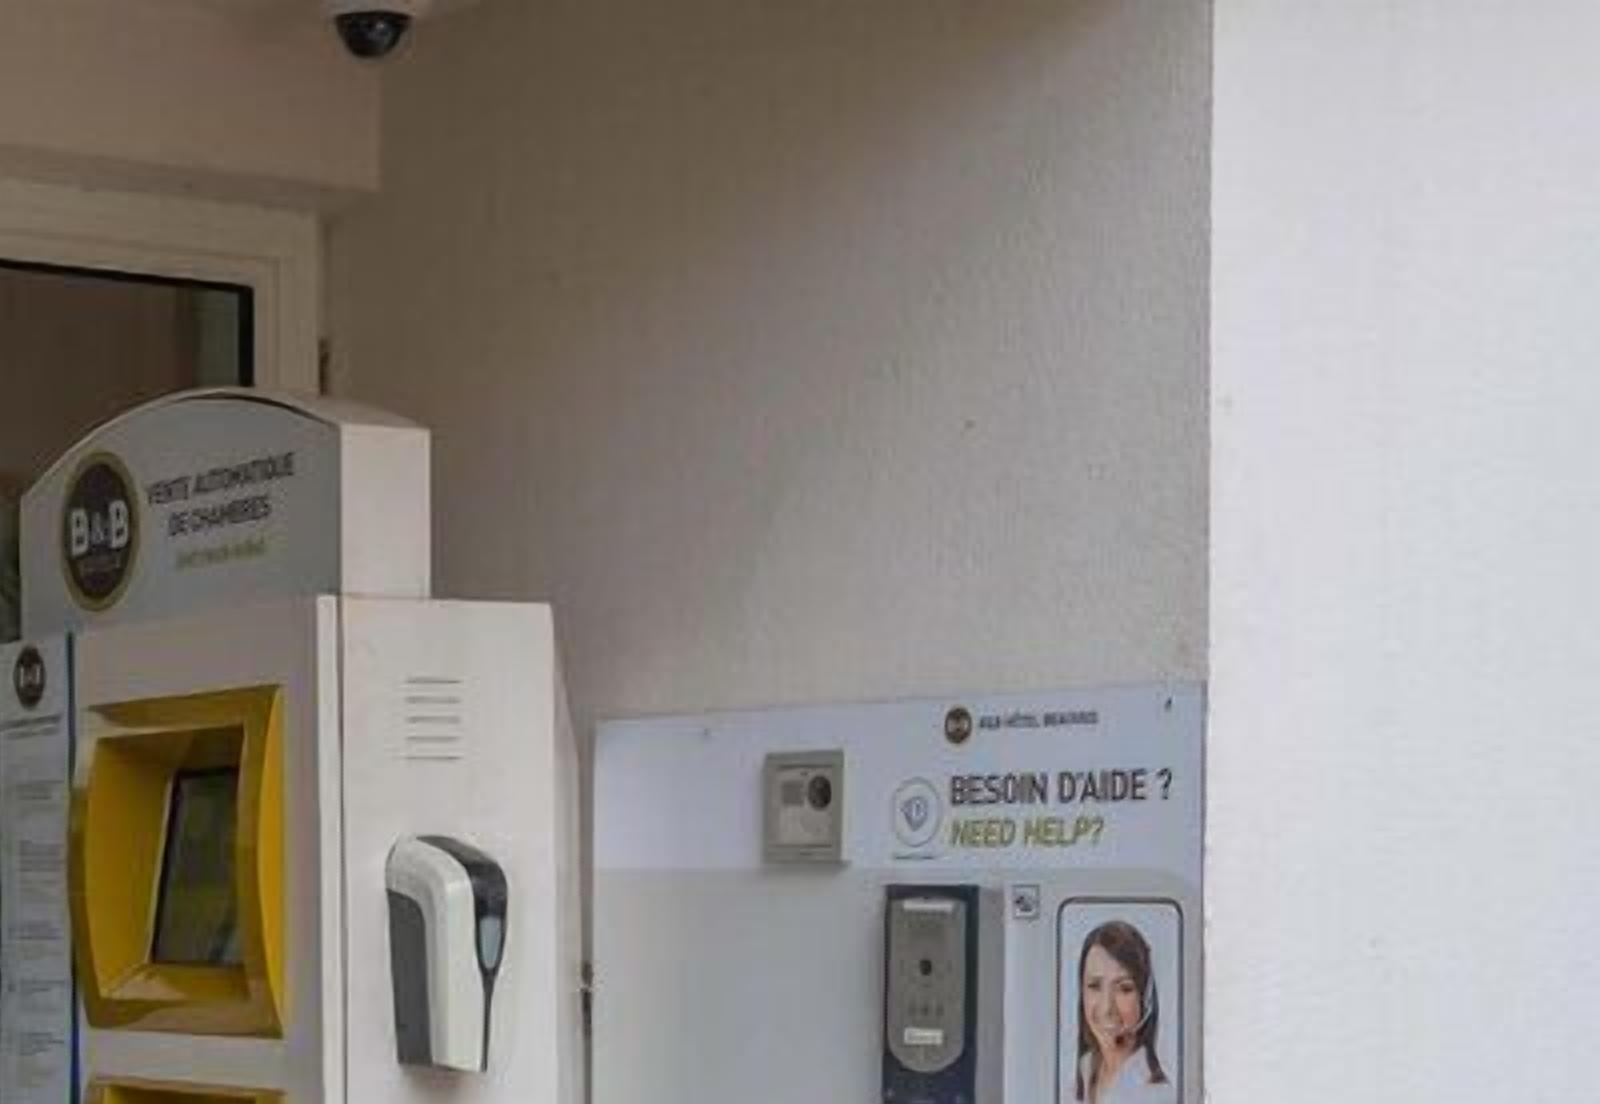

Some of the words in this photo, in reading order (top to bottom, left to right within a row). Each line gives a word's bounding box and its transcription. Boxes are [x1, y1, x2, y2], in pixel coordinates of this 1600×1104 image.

[193, 452, 294, 493] AUTOMATIQUE
[951, 774, 1049, 806] BESOIN
[1057, 768, 1148, 803] D'AIDE
[1156, 767, 1173, 800] ?
[952, 818, 1016, 847] NEED
[1023, 815, 1105, 846] HELP?
